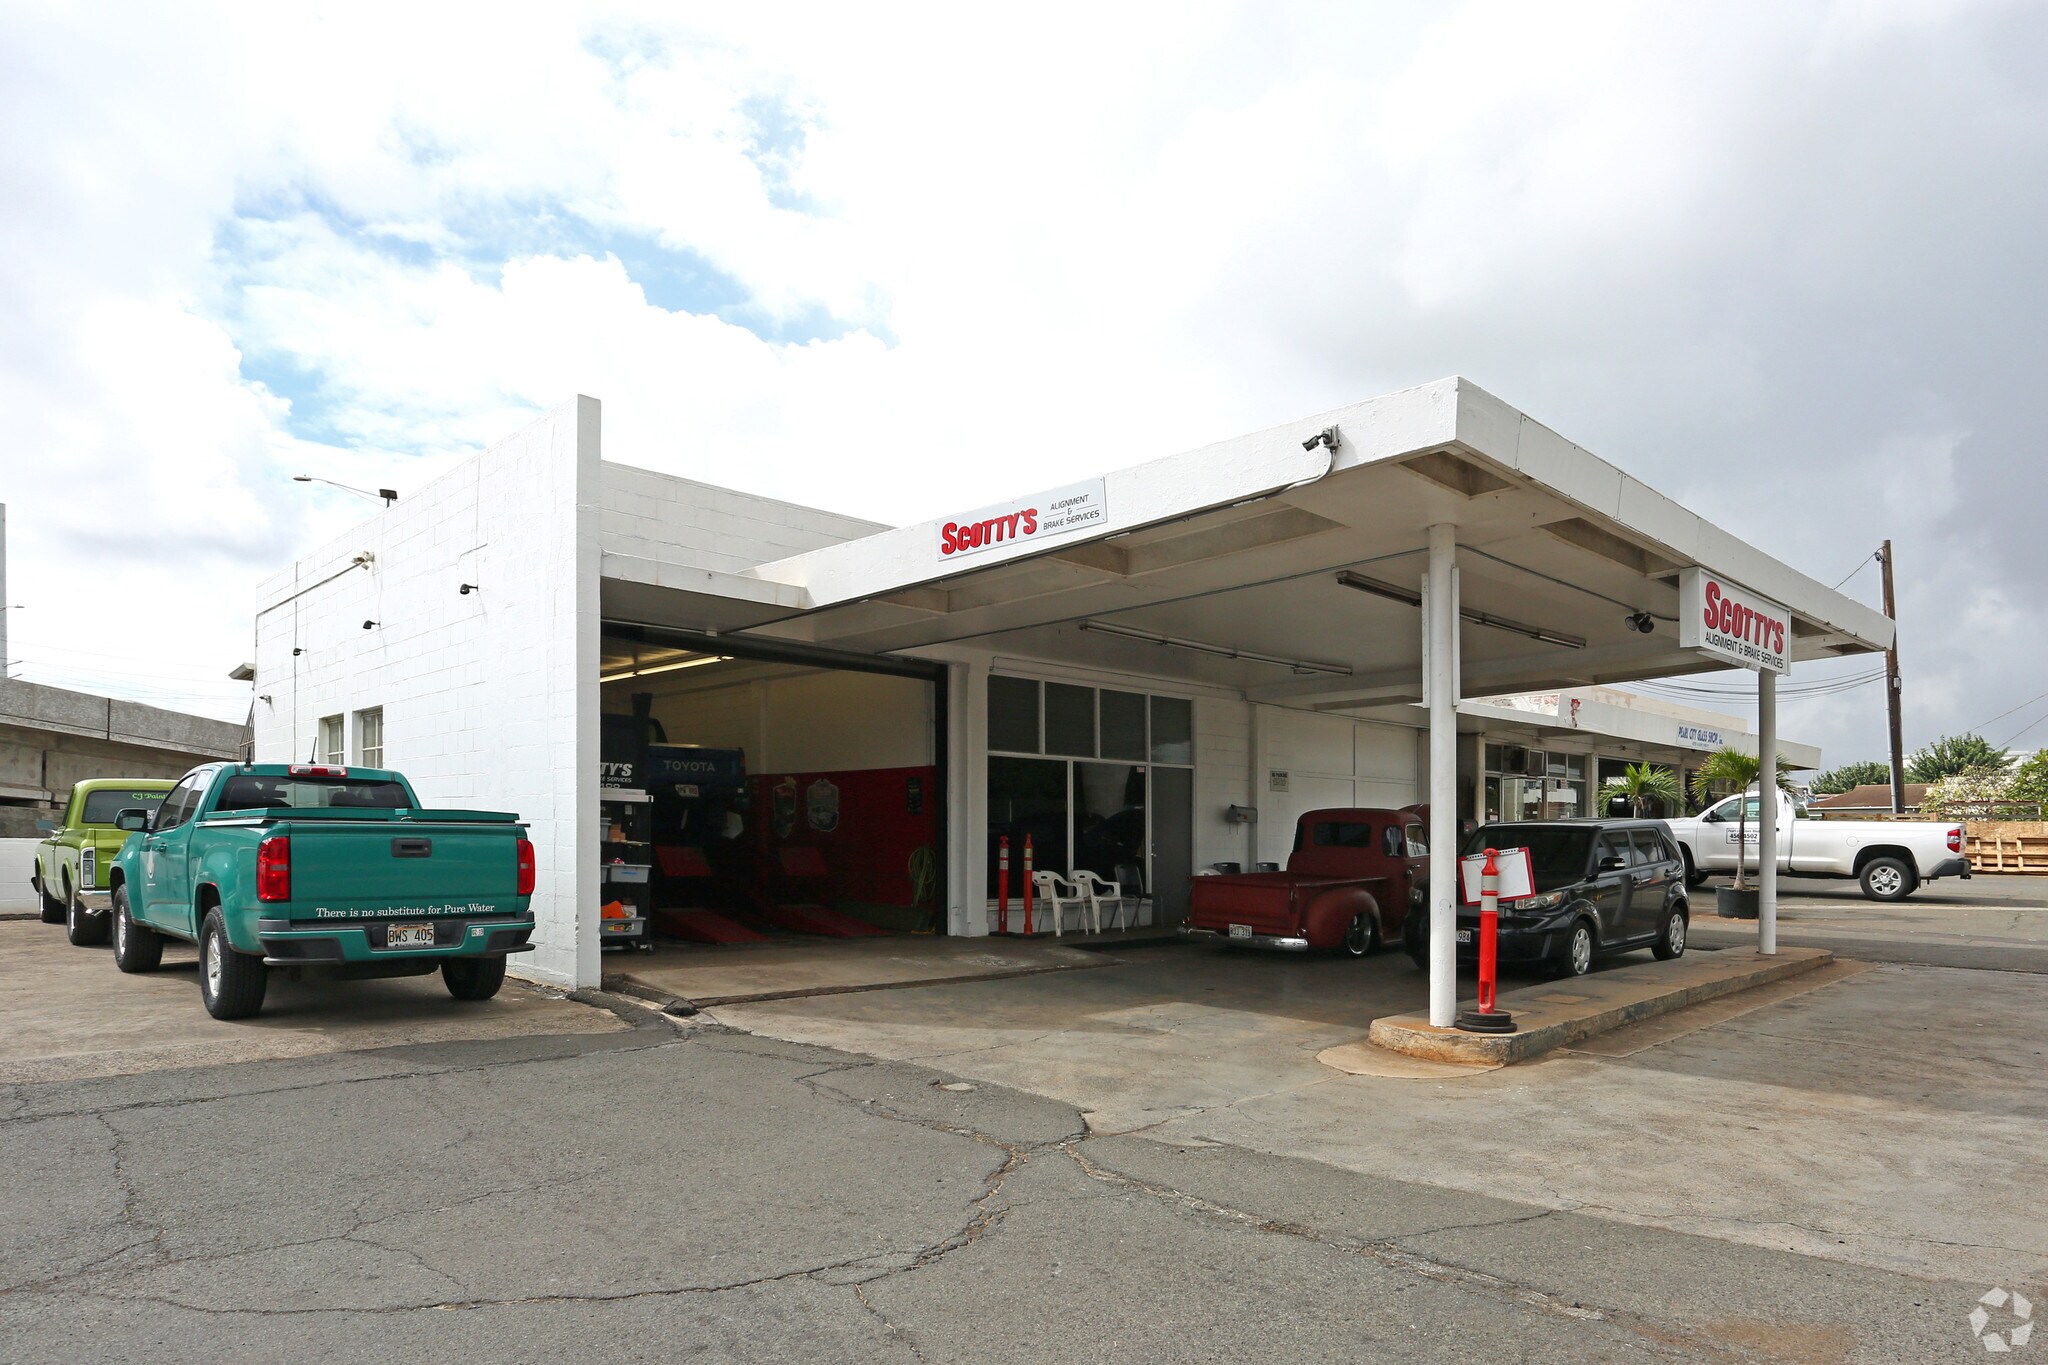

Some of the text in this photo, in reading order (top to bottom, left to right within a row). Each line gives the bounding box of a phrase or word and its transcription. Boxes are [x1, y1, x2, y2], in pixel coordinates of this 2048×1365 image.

[1050, 494, 1089, 511] ALIGNMENT
[1067, 507, 1073, 515] &
[1043, 509, 1100, 530] BRAKE SERVICES
[941, 508, 1038, 555] SCOTTY'S
[1703, 581, 1784, 655] SCOTTY'S
[1705, 631, 1784, 669] ALIGNMENT & BRAKE SERVICES
[600, 762, 632, 777] TY'S
[664, 760, 716, 772] TOYOTA
[316, 903, 495, 918] There is no substitute for Pure Water
[388, 928, 433, 943] BWS 405
